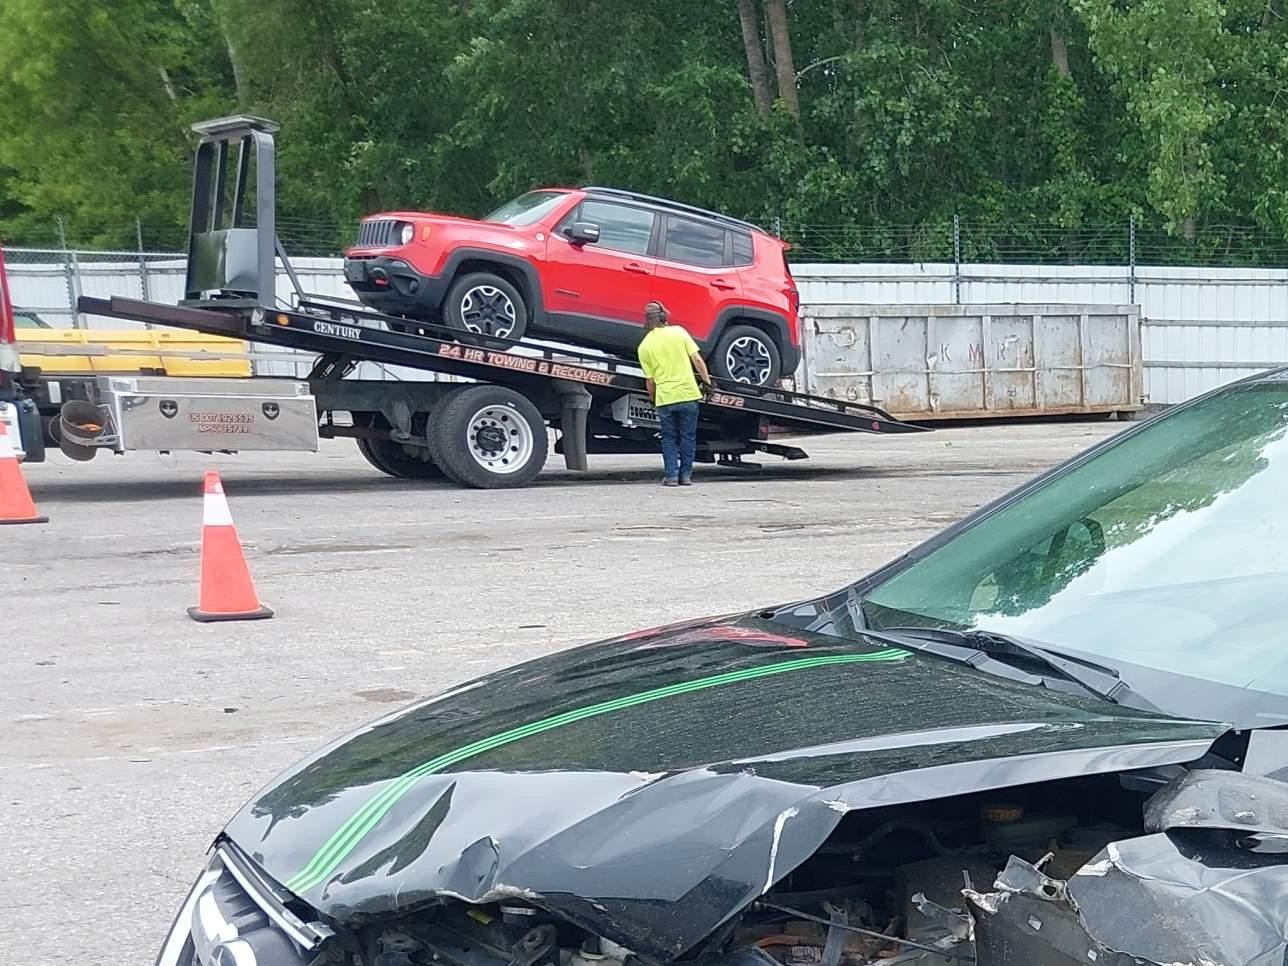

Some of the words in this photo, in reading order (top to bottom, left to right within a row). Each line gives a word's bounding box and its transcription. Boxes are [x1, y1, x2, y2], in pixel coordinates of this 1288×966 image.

[314, 321, 361, 340] CENTURY
[439, 343, 462, 359] 24
[464, 348, 485, 362] HR
[487, 352, 537, 370] TOWING
[539, 362, 549, 373] &
[551, 364, 616, 385] RECOVERY
